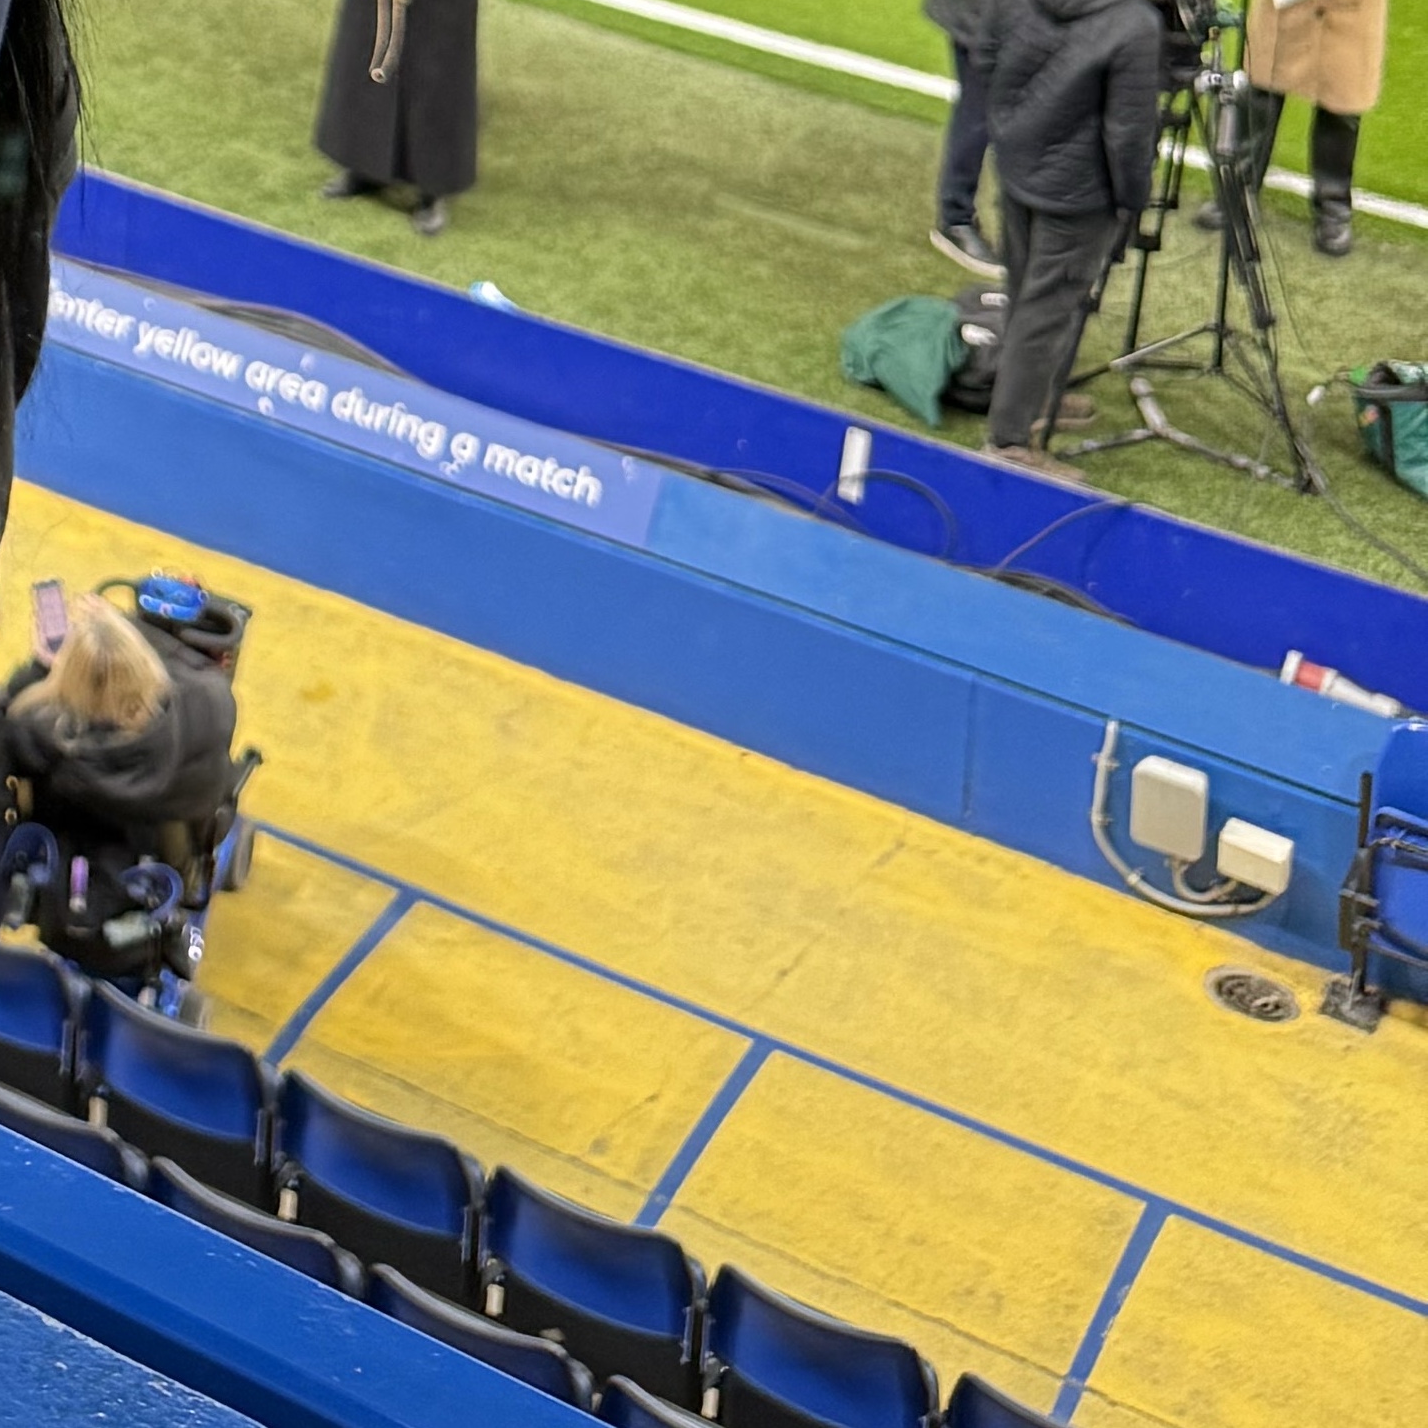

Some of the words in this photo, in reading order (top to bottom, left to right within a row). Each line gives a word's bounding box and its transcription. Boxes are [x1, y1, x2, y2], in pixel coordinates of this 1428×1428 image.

[132, 320, 244, 381] yellow
[245, 360, 329, 414] area
[331, 385, 448, 461] during
[449, 432, 481, 465] a
[483, 442, 603, 507] match
